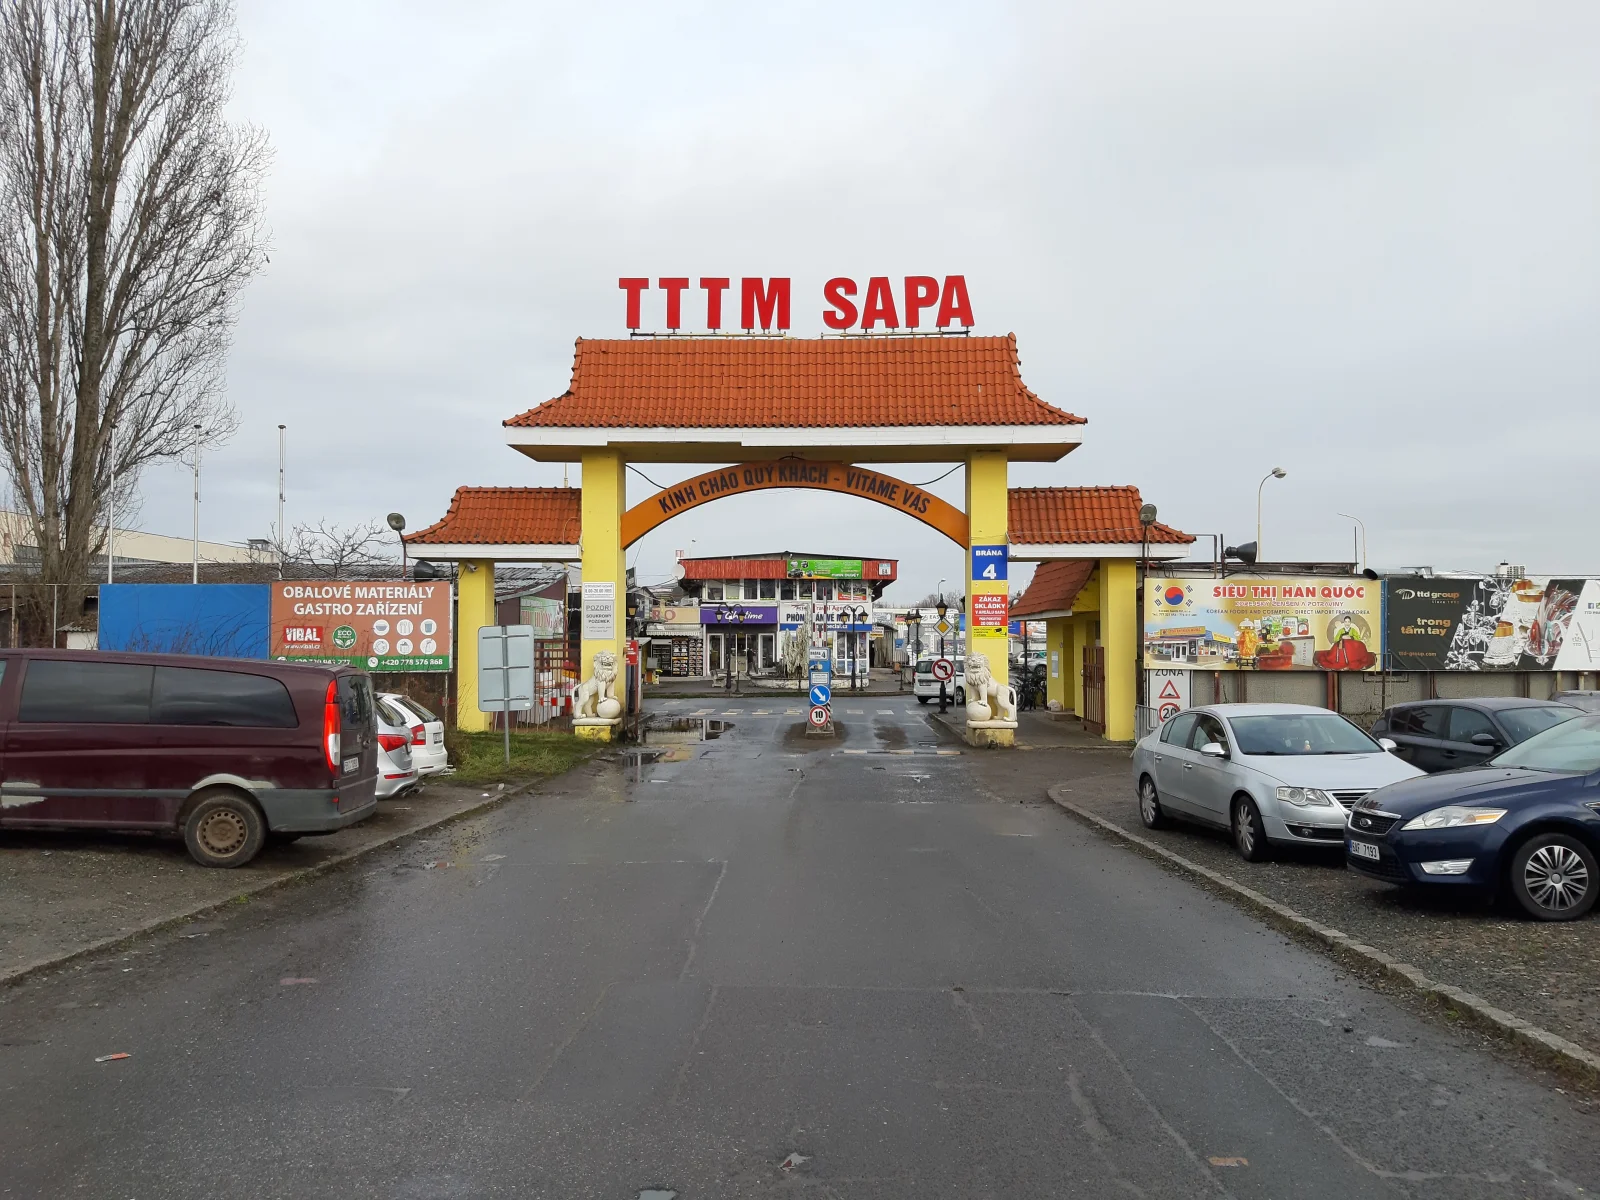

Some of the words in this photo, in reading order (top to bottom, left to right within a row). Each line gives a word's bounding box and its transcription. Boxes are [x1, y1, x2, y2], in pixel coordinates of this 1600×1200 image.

[619, 277, 790, 330] TTTM
[822, 275, 974, 330] SAPA
[658, 485, 696, 514] KÍNH
[699, 472, 739, 496] CHÀO
[846, 470, 899, 501] VÍTÁME
[902, 489, 931, 514] VÁS
[982, 564, 996, 580] 4
[283, 585, 351, 598] OBALOVÉ
[355, 585, 434, 598] MATERIÁLY
[1213, 584, 1247, 598] SIÊU
[1252, 586, 1276, 600] THỊ
[1282, 584, 1316, 598] HÀN
[1321, 583, 1364, 598] QUỐC
[294, 603, 352, 615] GASTRO
[356, 601, 423, 615] ZAŘÍZENÍ
[786, 612, 805, 622] PHÒN
[1417, 617, 1451, 627] trong
[1427, 626, 1447, 636] tay
